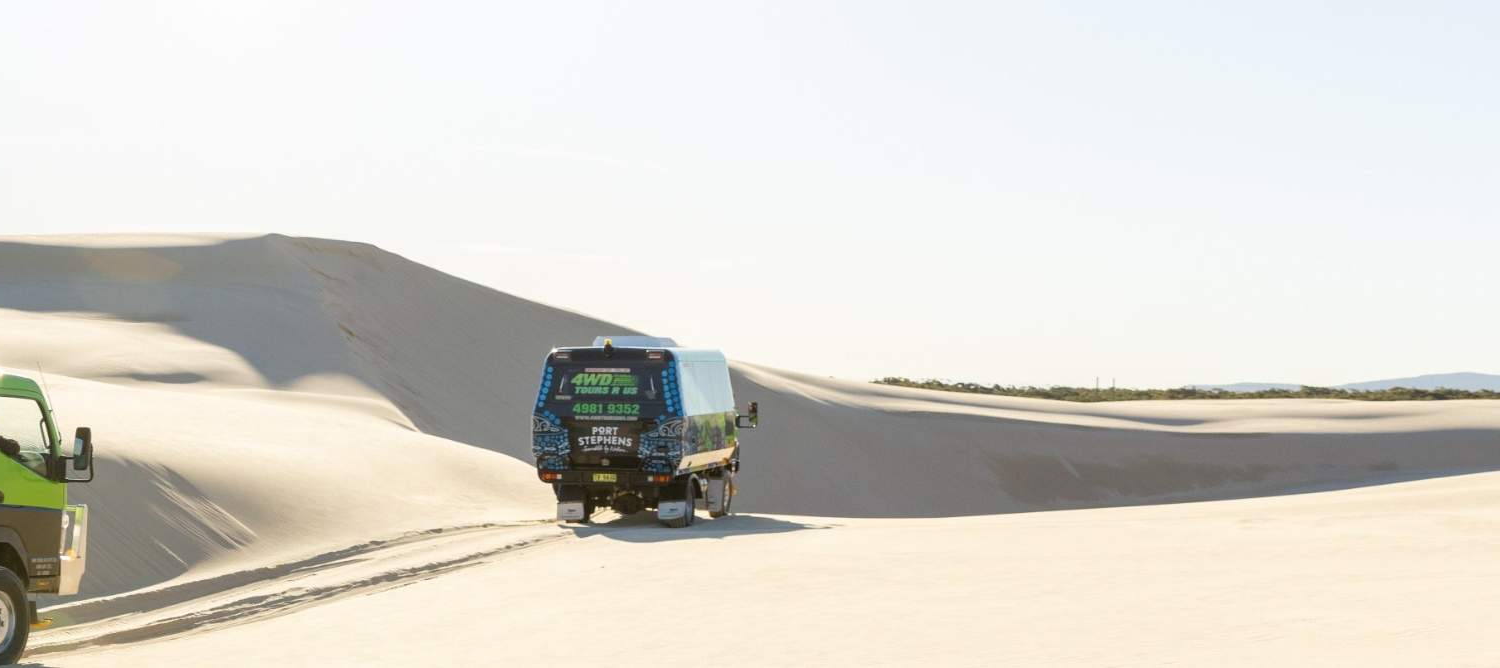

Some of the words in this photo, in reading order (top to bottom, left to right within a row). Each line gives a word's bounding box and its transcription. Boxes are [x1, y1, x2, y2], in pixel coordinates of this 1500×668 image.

[571, 373, 613, 386] 4WD
[575, 386, 609, 395] TOURS
[572, 403, 603, 415] 4981
[607, 403, 640, 415] 9352
[592, 426, 619, 436] PORT
[578, 435, 633, 447] STEPHENS
